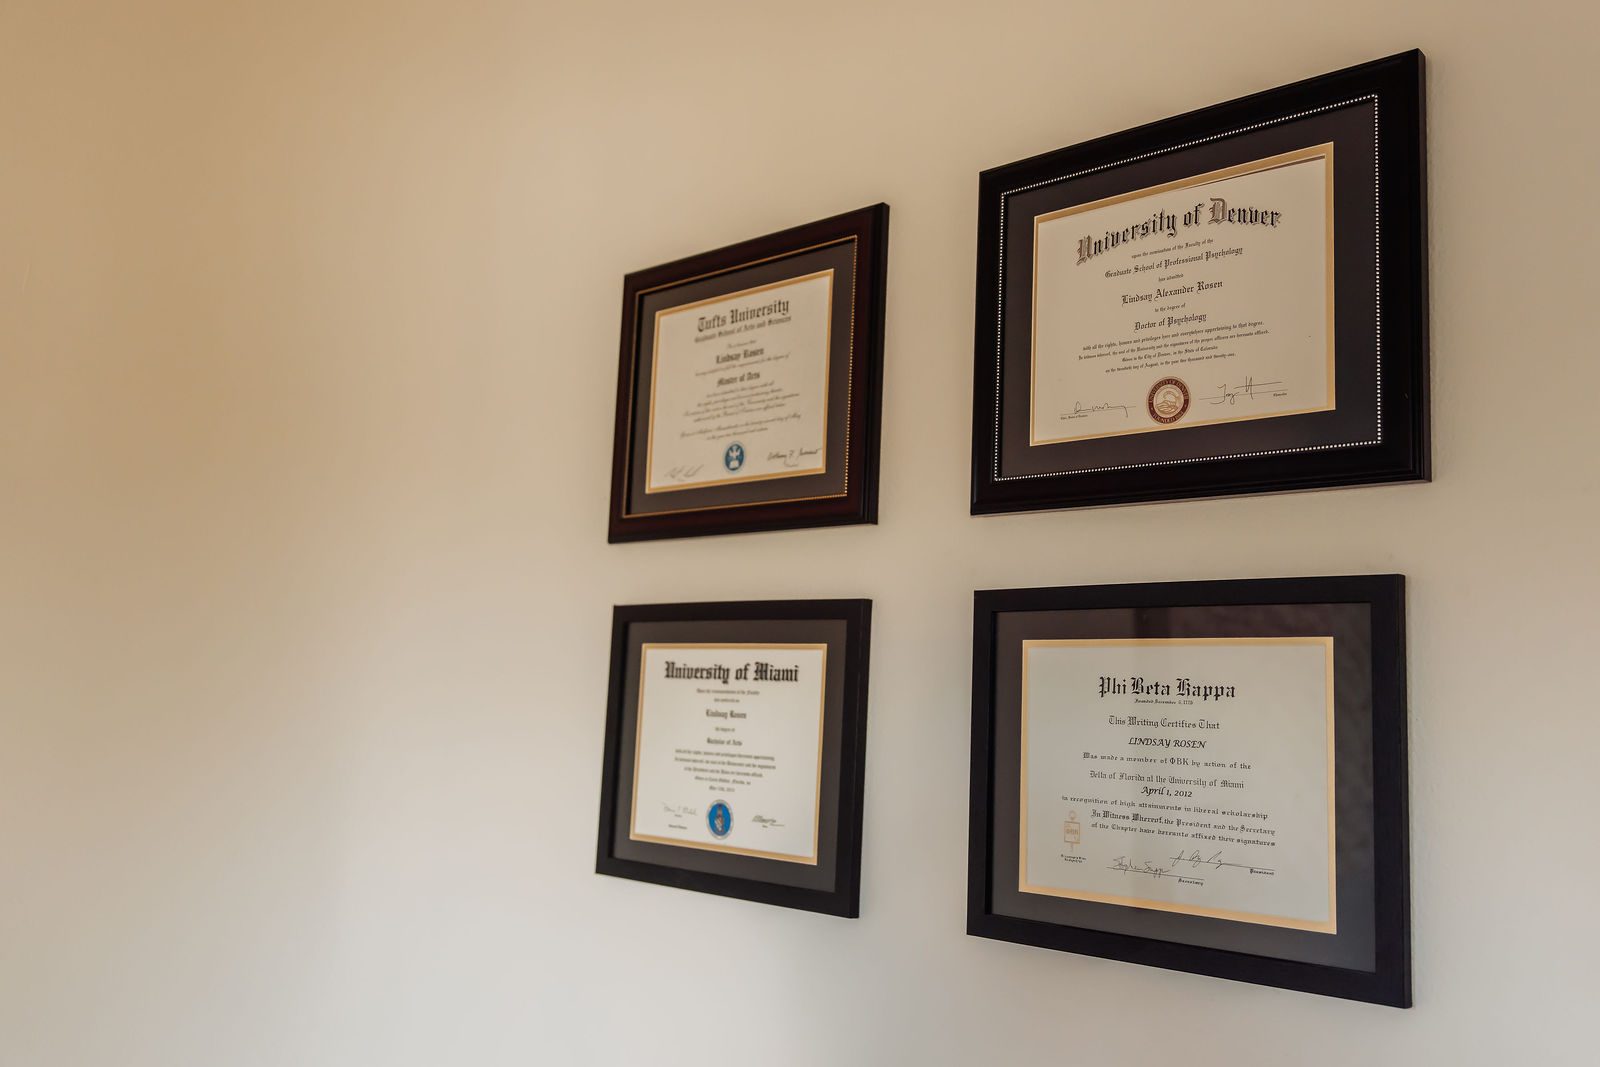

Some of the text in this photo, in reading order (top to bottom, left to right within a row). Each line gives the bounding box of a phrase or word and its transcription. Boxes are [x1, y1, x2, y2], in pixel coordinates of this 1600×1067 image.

[1075, 197, 1282, 266] University of Denver
[1105, 268, 1131, 278] Graduate
[1133, 262, 1154, 274] School
[1164, 251, 1203, 269] Professional
[1206, 248, 1242, 261] Psychology
[1122, 281, 1222, 306] Lindsay Alexander Rosen
[698, 299, 789, 332] Tufts University
[1134, 314, 1206, 333] Doctor of Psychology
[664, 661, 799, 685] University of Miami
[1099, 676, 1236, 701] Phi Beta Kappa
[1108, 715, 1219, 729] This Writing Certifies That
[1128, 738, 1206, 748] LINDSAY ROSEN
[1083, 752, 1098, 760] Was
[1119, 772, 1144, 781] Florida
[1156, 776, 1166, 784] the
[1169, 776, 1206, 788] University
[1220, 780, 1244, 788] Miami
[1141, 786, 1165, 796] April
[1070, 796, 1108, 804] recognition
[1120, 800, 1135, 808] high
[1194, 806, 1218, 814] liberal
[1222, 810, 1268, 820] scholarship
[1091, 809, 1101, 818] In
[1102, 810, 1130, 820] Witness
[1176, 819, 1210, 828] President
[1240, 824, 1275, 836] Secretary
[1111, 824, 1137, 832] Chapter
